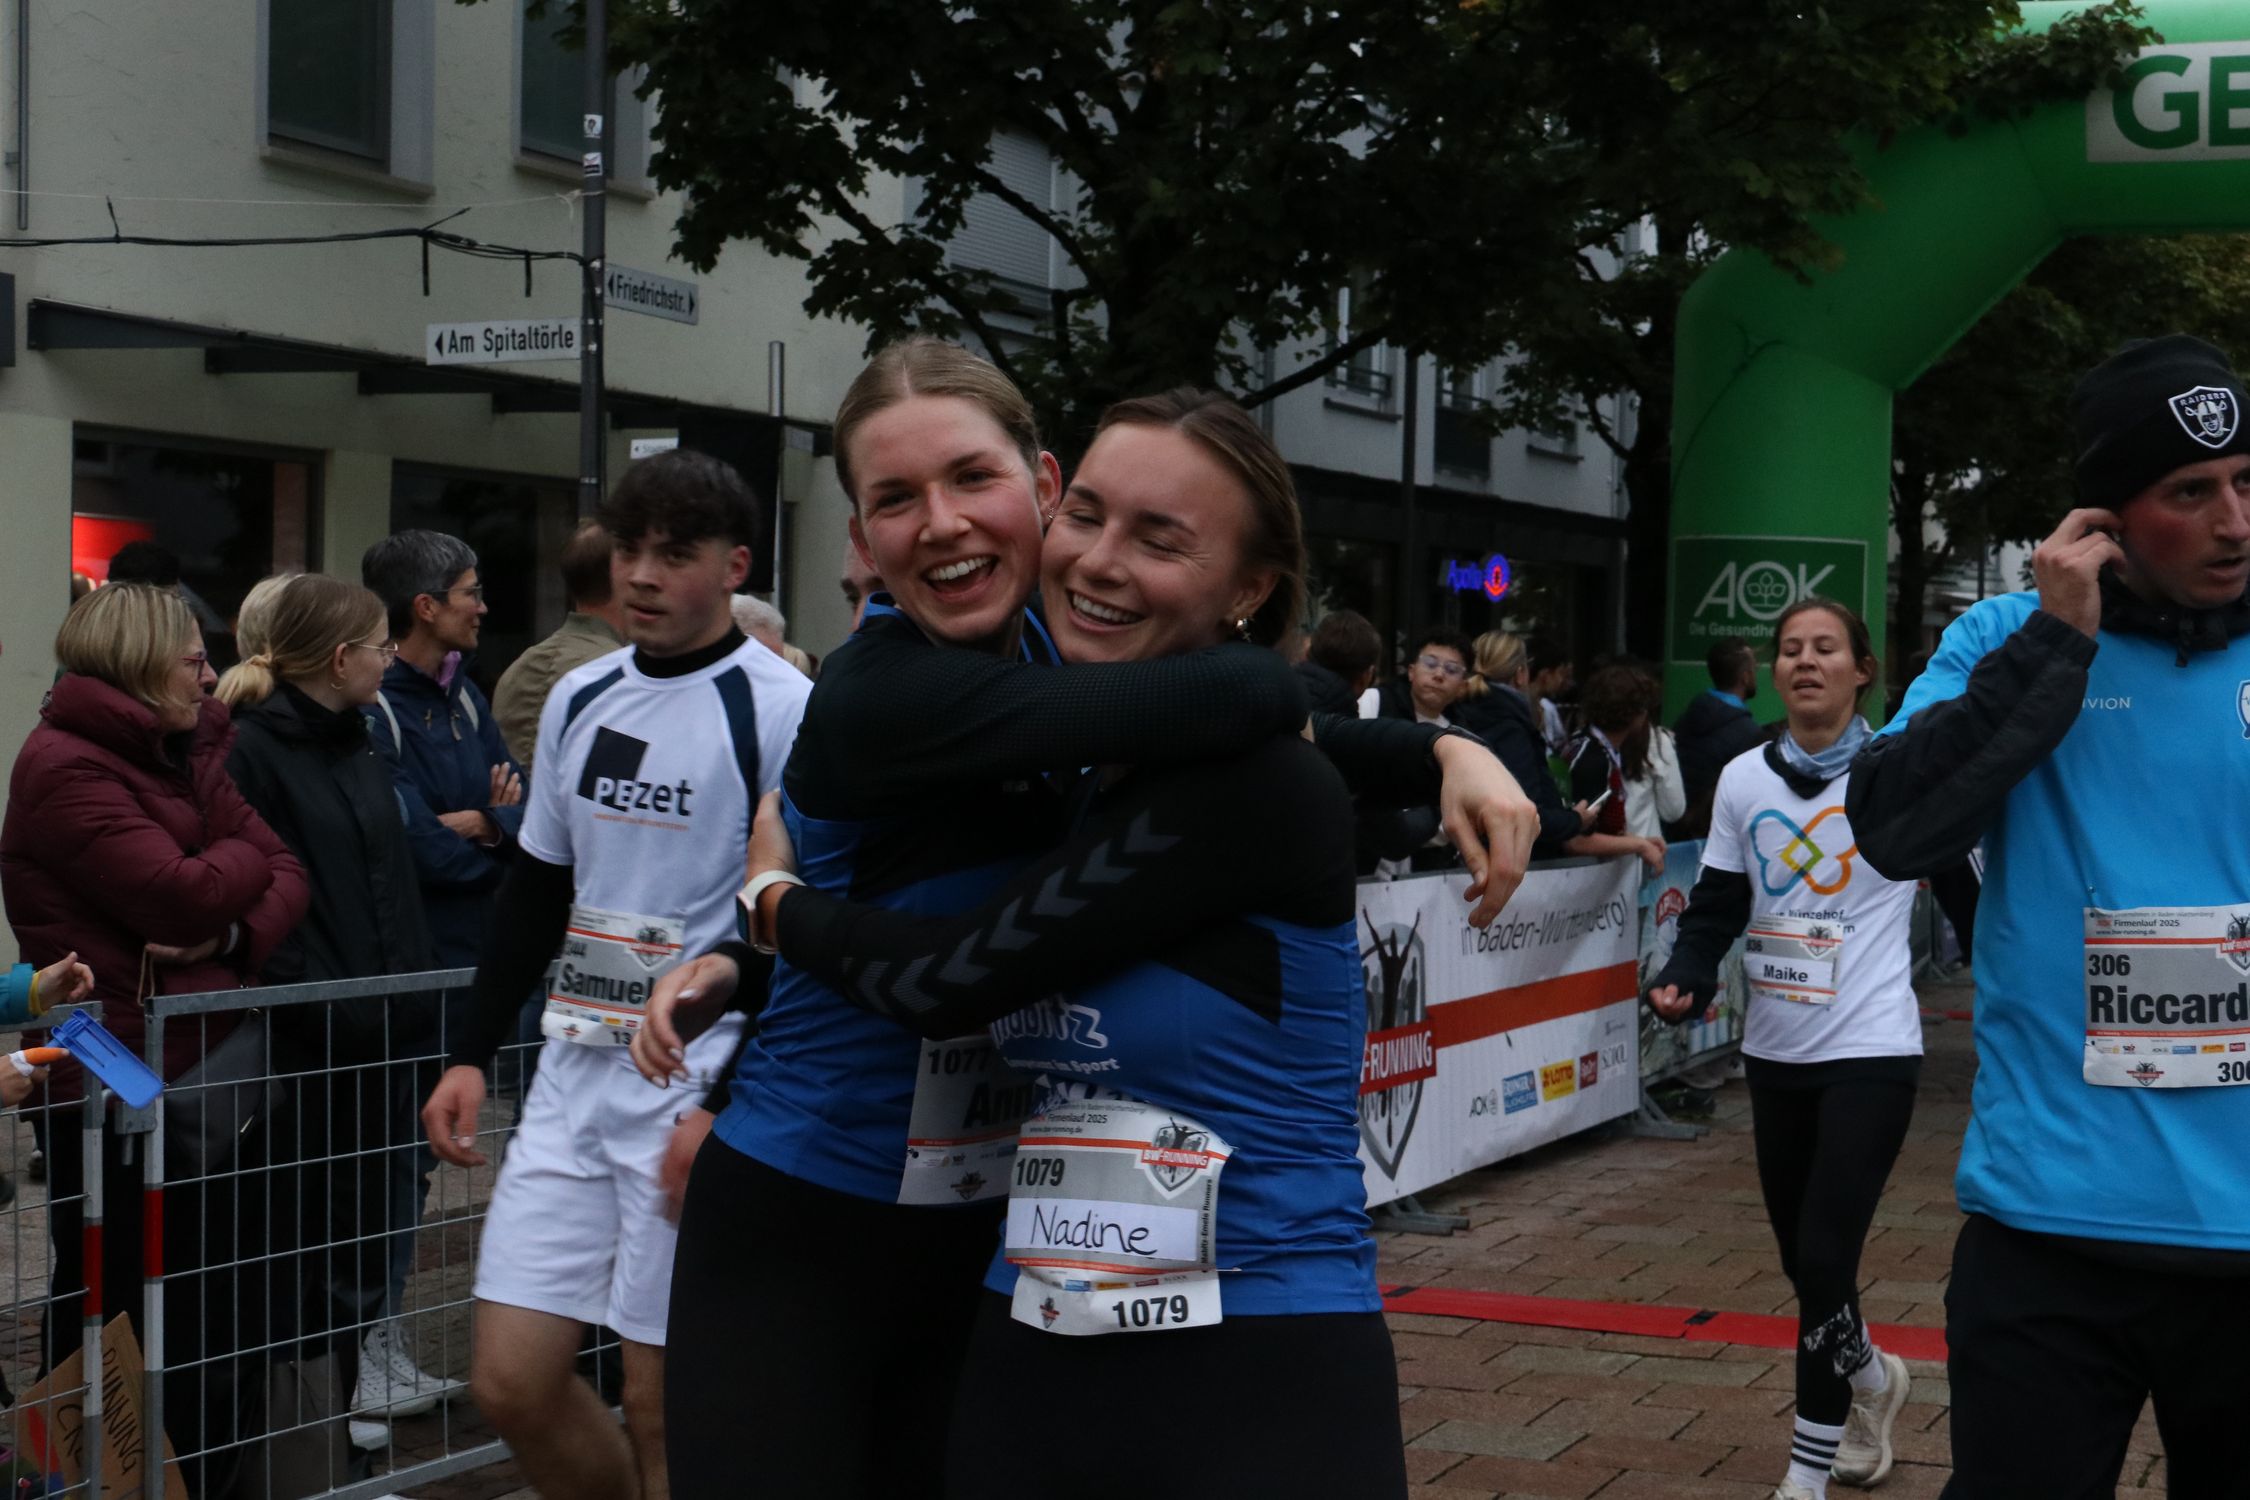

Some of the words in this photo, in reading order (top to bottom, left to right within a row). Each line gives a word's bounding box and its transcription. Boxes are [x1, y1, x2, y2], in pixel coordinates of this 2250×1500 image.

[616, 275, 685, 313] Friedrichstr.
[448, 329, 475, 353] Am
[484, 325, 574, 357] Spitaltörle
[2180, 392, 2227, 406] RAIDERS
[1694, 560, 1837, 621] AOK
[1689, 621, 1706, 636] Die
[2114, 919, 2157, 927] Firmenlauf
[2159, 919, 2180, 927] 2025
[1763, 964, 1808, 982] Maike
[2088, 954, 2130, 976] 306
[560, 963, 655, 1004] Samuel
[2089, 982, 2250, 1025] Riccard
[928, 1047, 992, 1075] 1077
[1070, 1057, 1121, 1075] Sport
[1360, 1030, 1433, 1083] -RUNNING
[1087, 1114, 1108, 1123] 2025
[1016, 1157, 1065, 1187] 1079
[1030, 1204, 1157, 1255] Nadine
[1112, 1295, 1189, 1328] 1079
